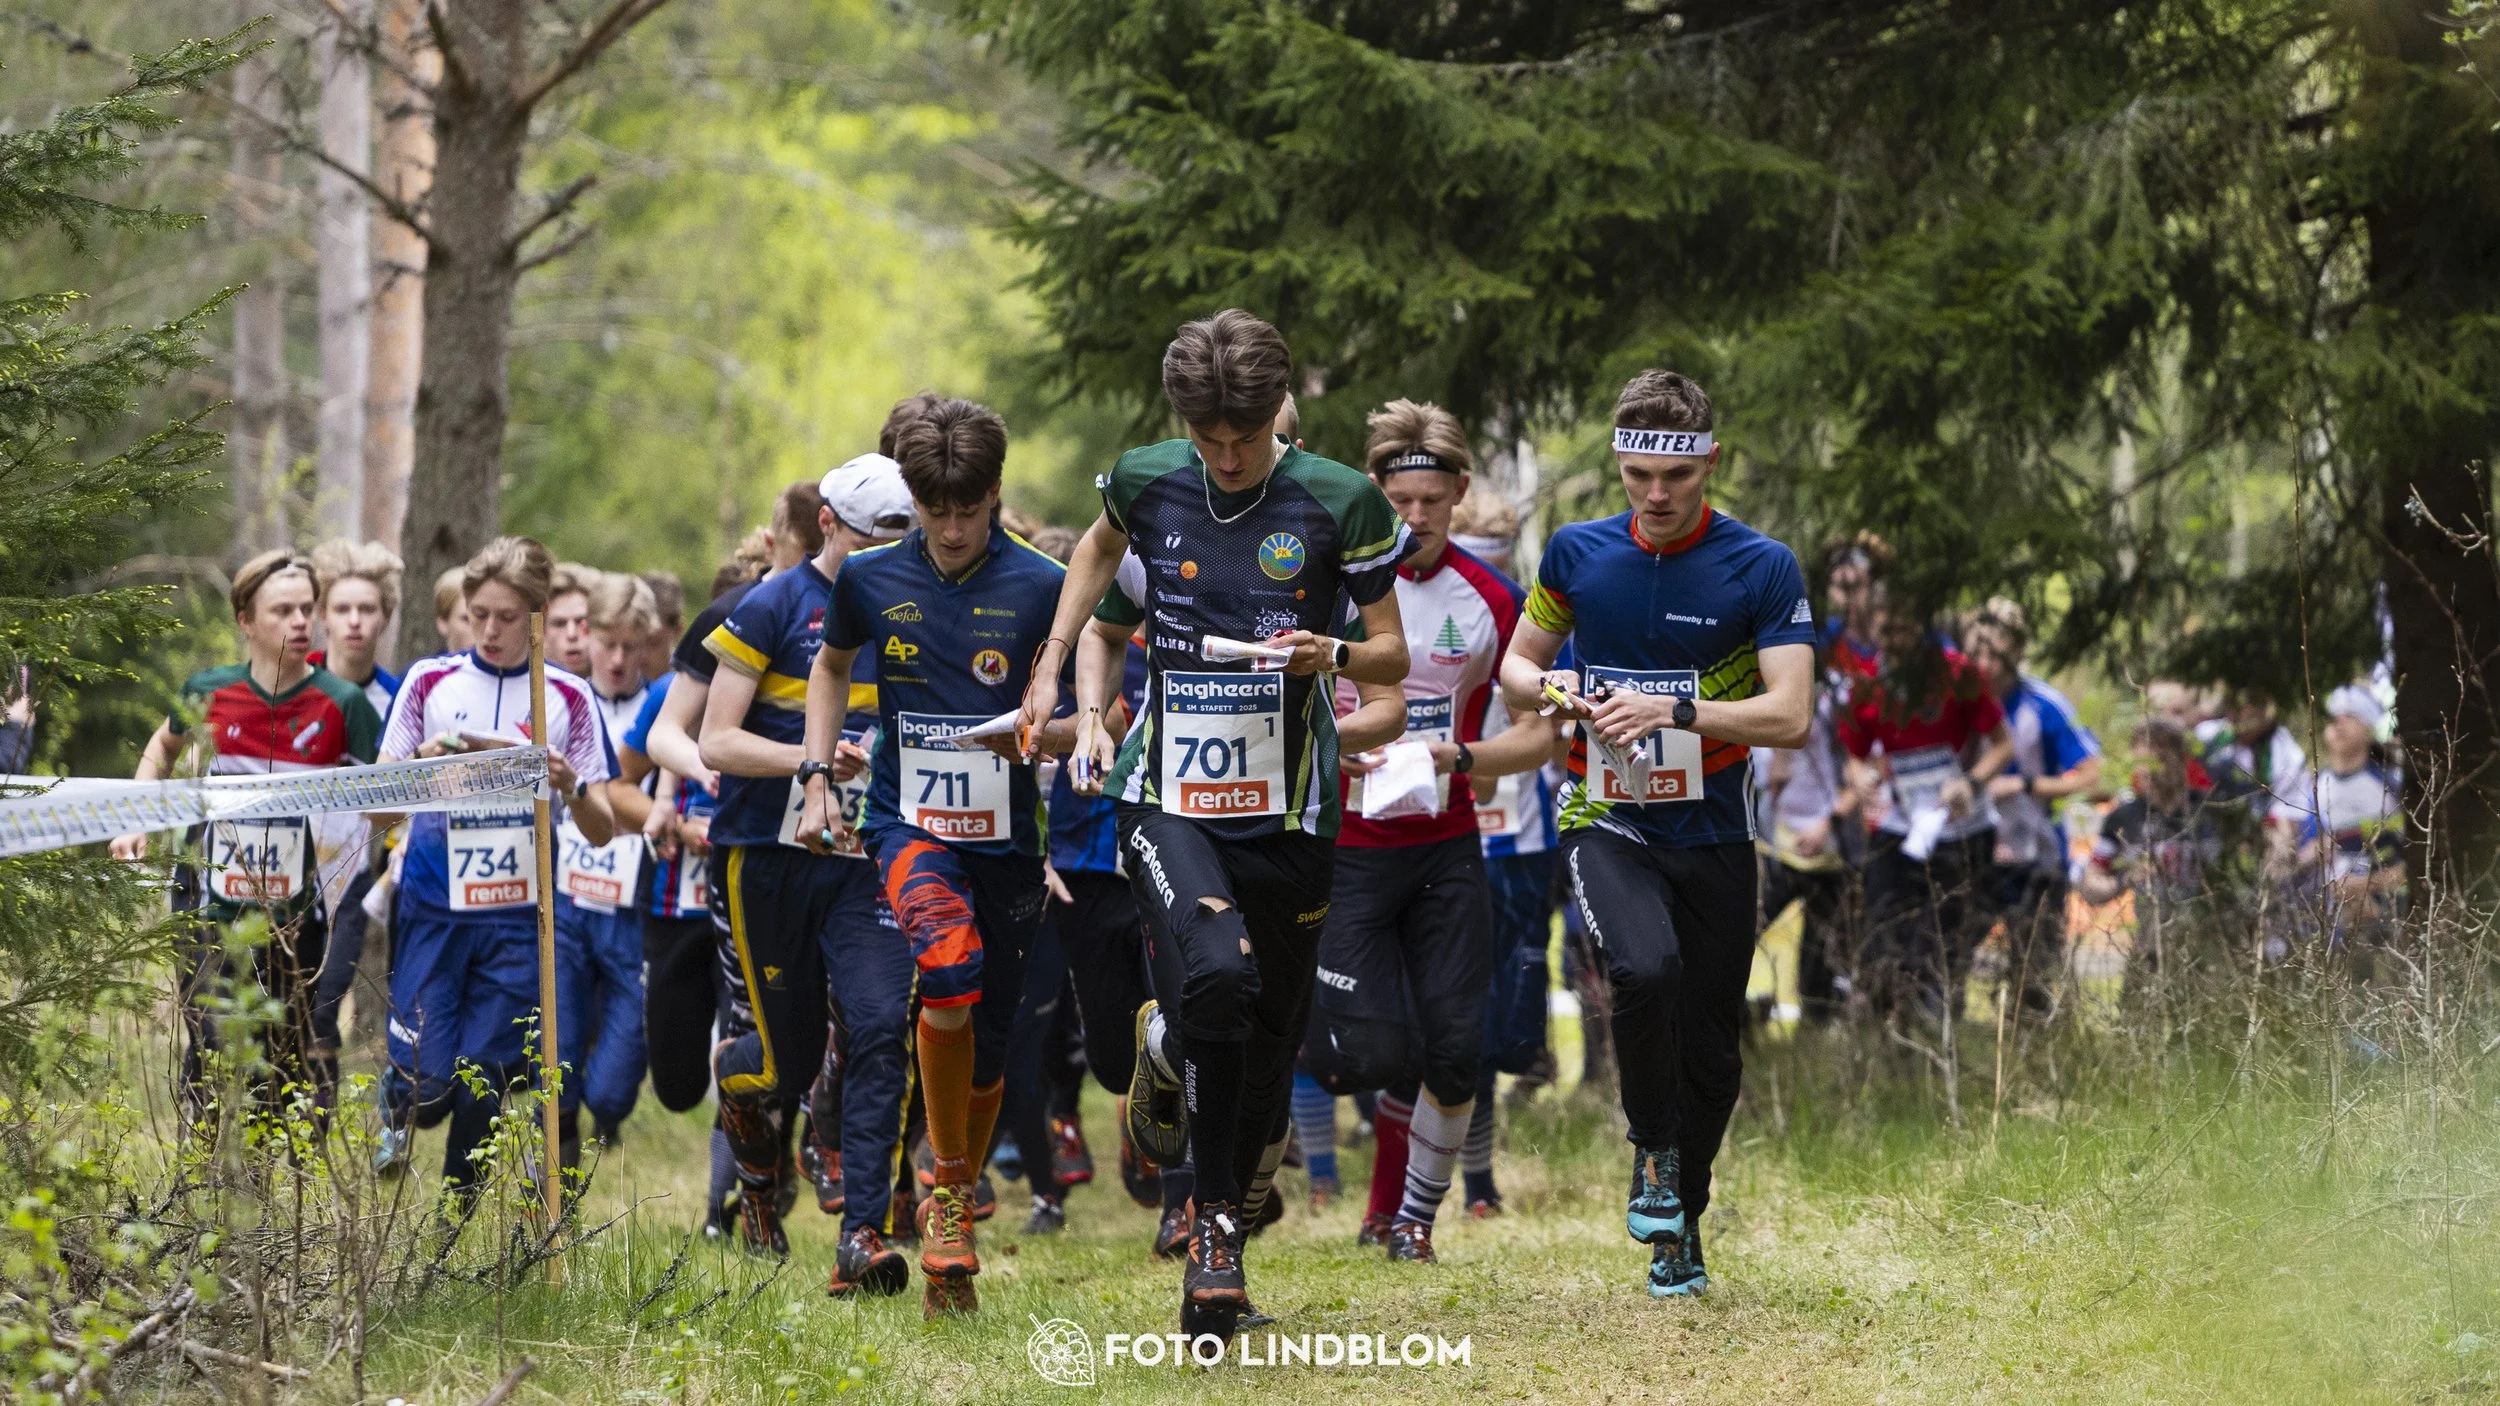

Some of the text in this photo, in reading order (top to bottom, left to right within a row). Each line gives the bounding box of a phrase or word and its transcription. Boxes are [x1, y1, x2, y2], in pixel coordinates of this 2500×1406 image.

[1618, 431, 1698, 453] TRIMTEX
[888, 608, 923, 624] aefab
[1665, 612, 1718, 627] Ronneby OK
[1167, 679, 1278, 700] bagheera
[1200, 704, 1233, 712] STAFETT
[1238, 704, 1258, 712] 2025
[1406, 702, 1451, 718] eera
[902, 719, 975, 737] baghe
[1264, 716, 1275, 738] 1
[992, 755, 1000, 772] 1
[1174, 737, 1247, 779] 701
[916, 768, 970, 808] 711
[1188, 788, 1261, 809] renta
[923, 815, 987, 834] renta
[219, 839, 281, 872] 744
[454, 846, 518, 878] 734
[564, 837, 616, 875] 764
[1131, 825, 1175, 909] bagheera
[469, 883, 524, 904] renta
